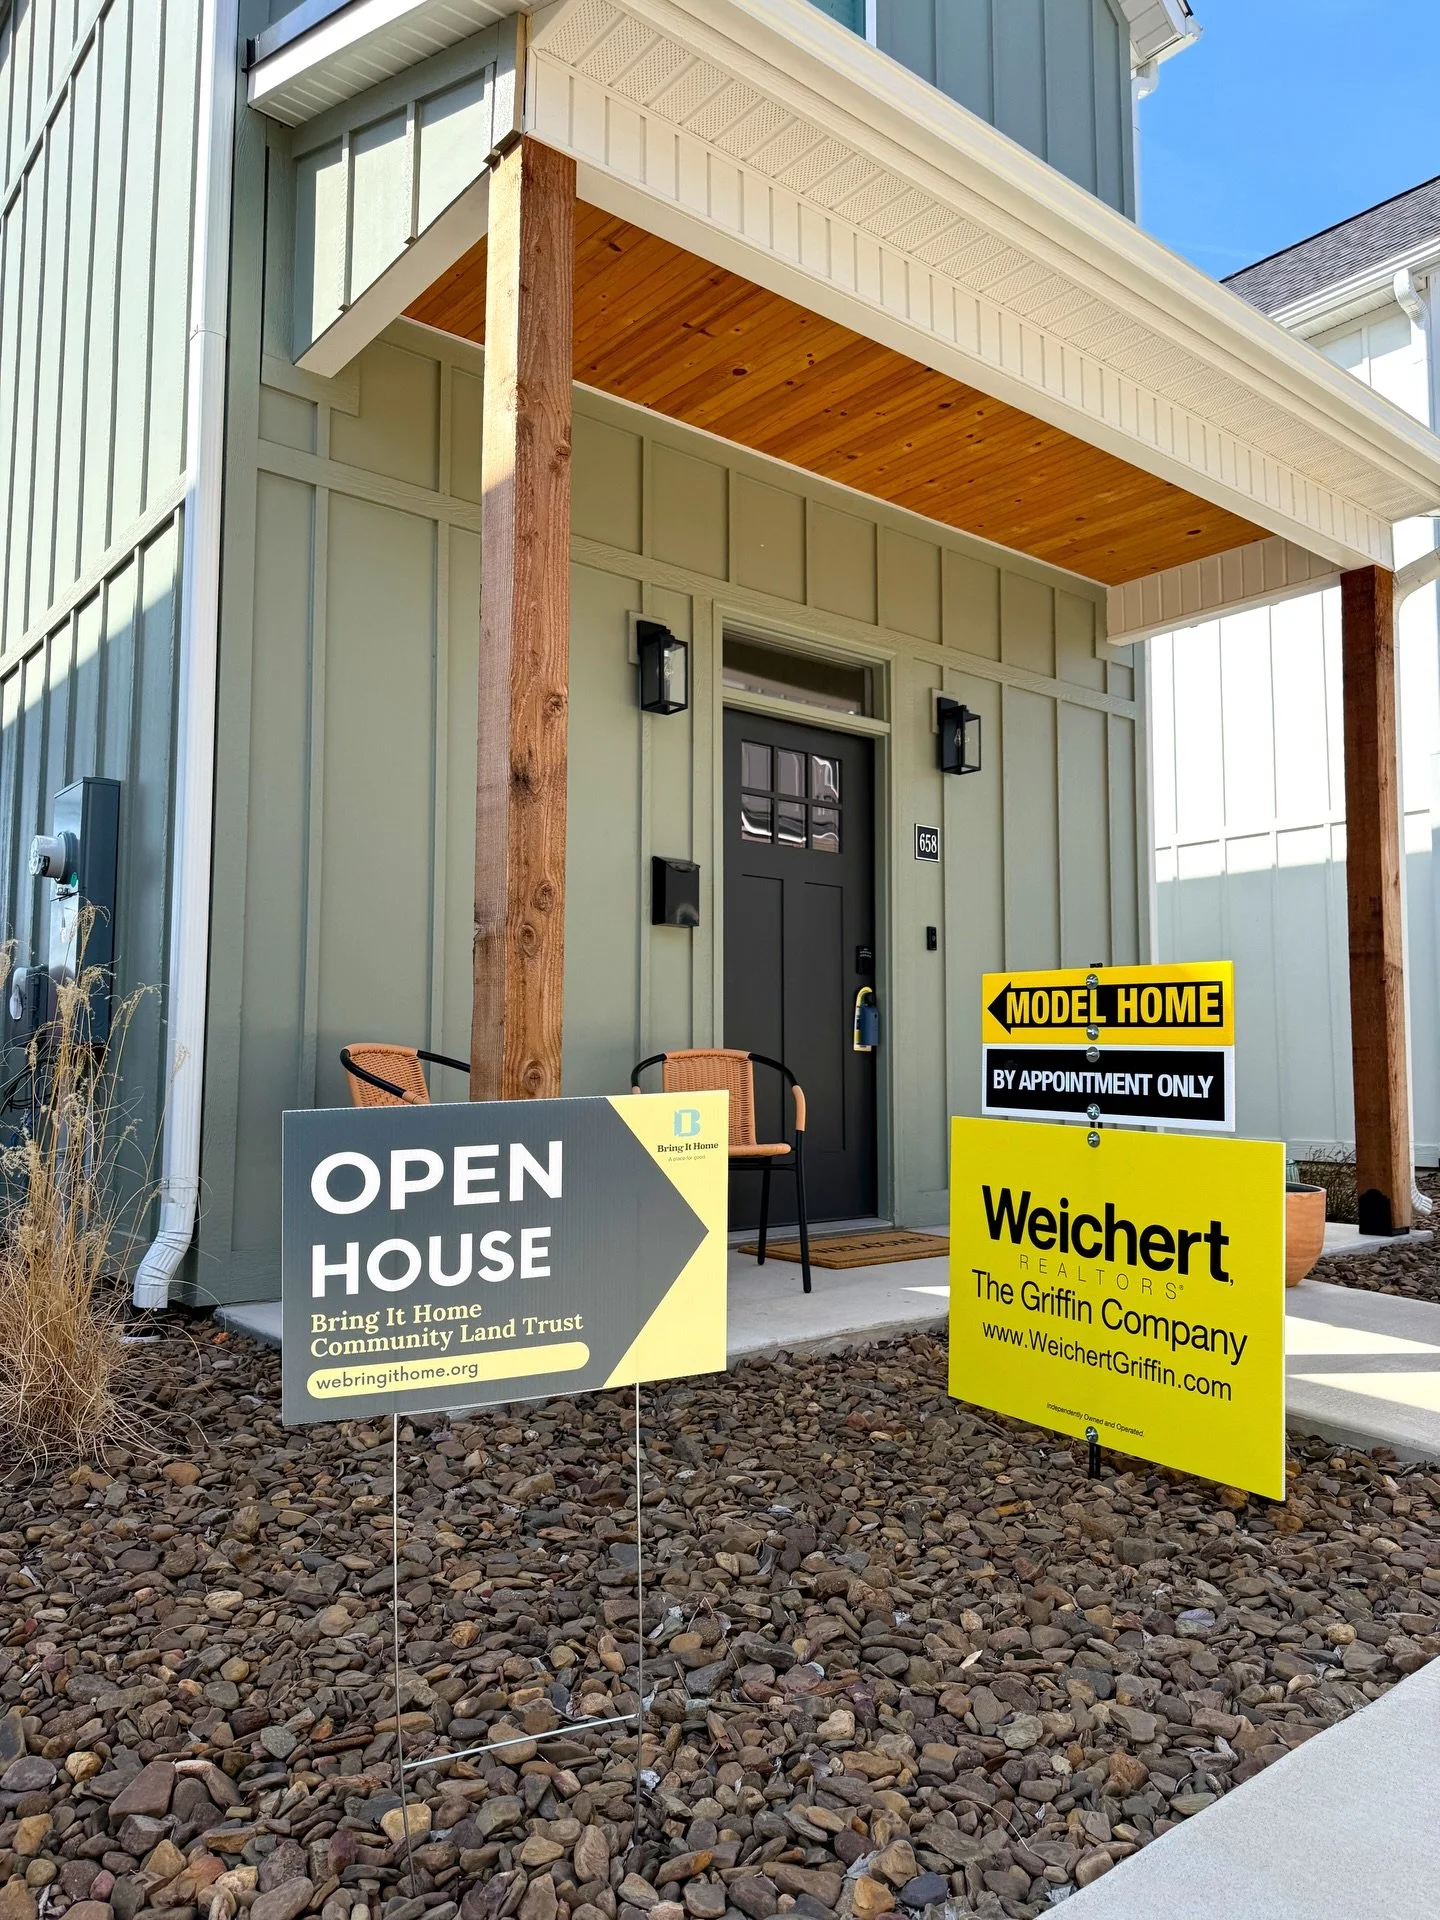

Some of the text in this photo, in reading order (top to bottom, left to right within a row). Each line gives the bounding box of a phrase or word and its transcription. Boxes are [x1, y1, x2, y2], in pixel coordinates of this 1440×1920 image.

[919, 833, 937, 853] 658
[1006, 985, 1220, 1025] MODEL HOME
[993, 1069, 1214, 1099] BY APPOINTMENT ONLY
[657, 1142, 719, 1153] Bring It Home
[310, 1140, 563, 1215] OPEN
[312, 1226, 552, 1298] HOUSE
[310, 1313, 584, 1357] Community Land Trust
[311, 1303, 482, 1334] Bring It Home
[971, 1268, 1248, 1366] The Griffin Company
[316, 1363, 479, 1390] webringithome.org
[982, 1321, 1232, 1401] www.WeichertGriffin.com
[1046, 1402, 1145, 1437] Independently Owned and Operated.
